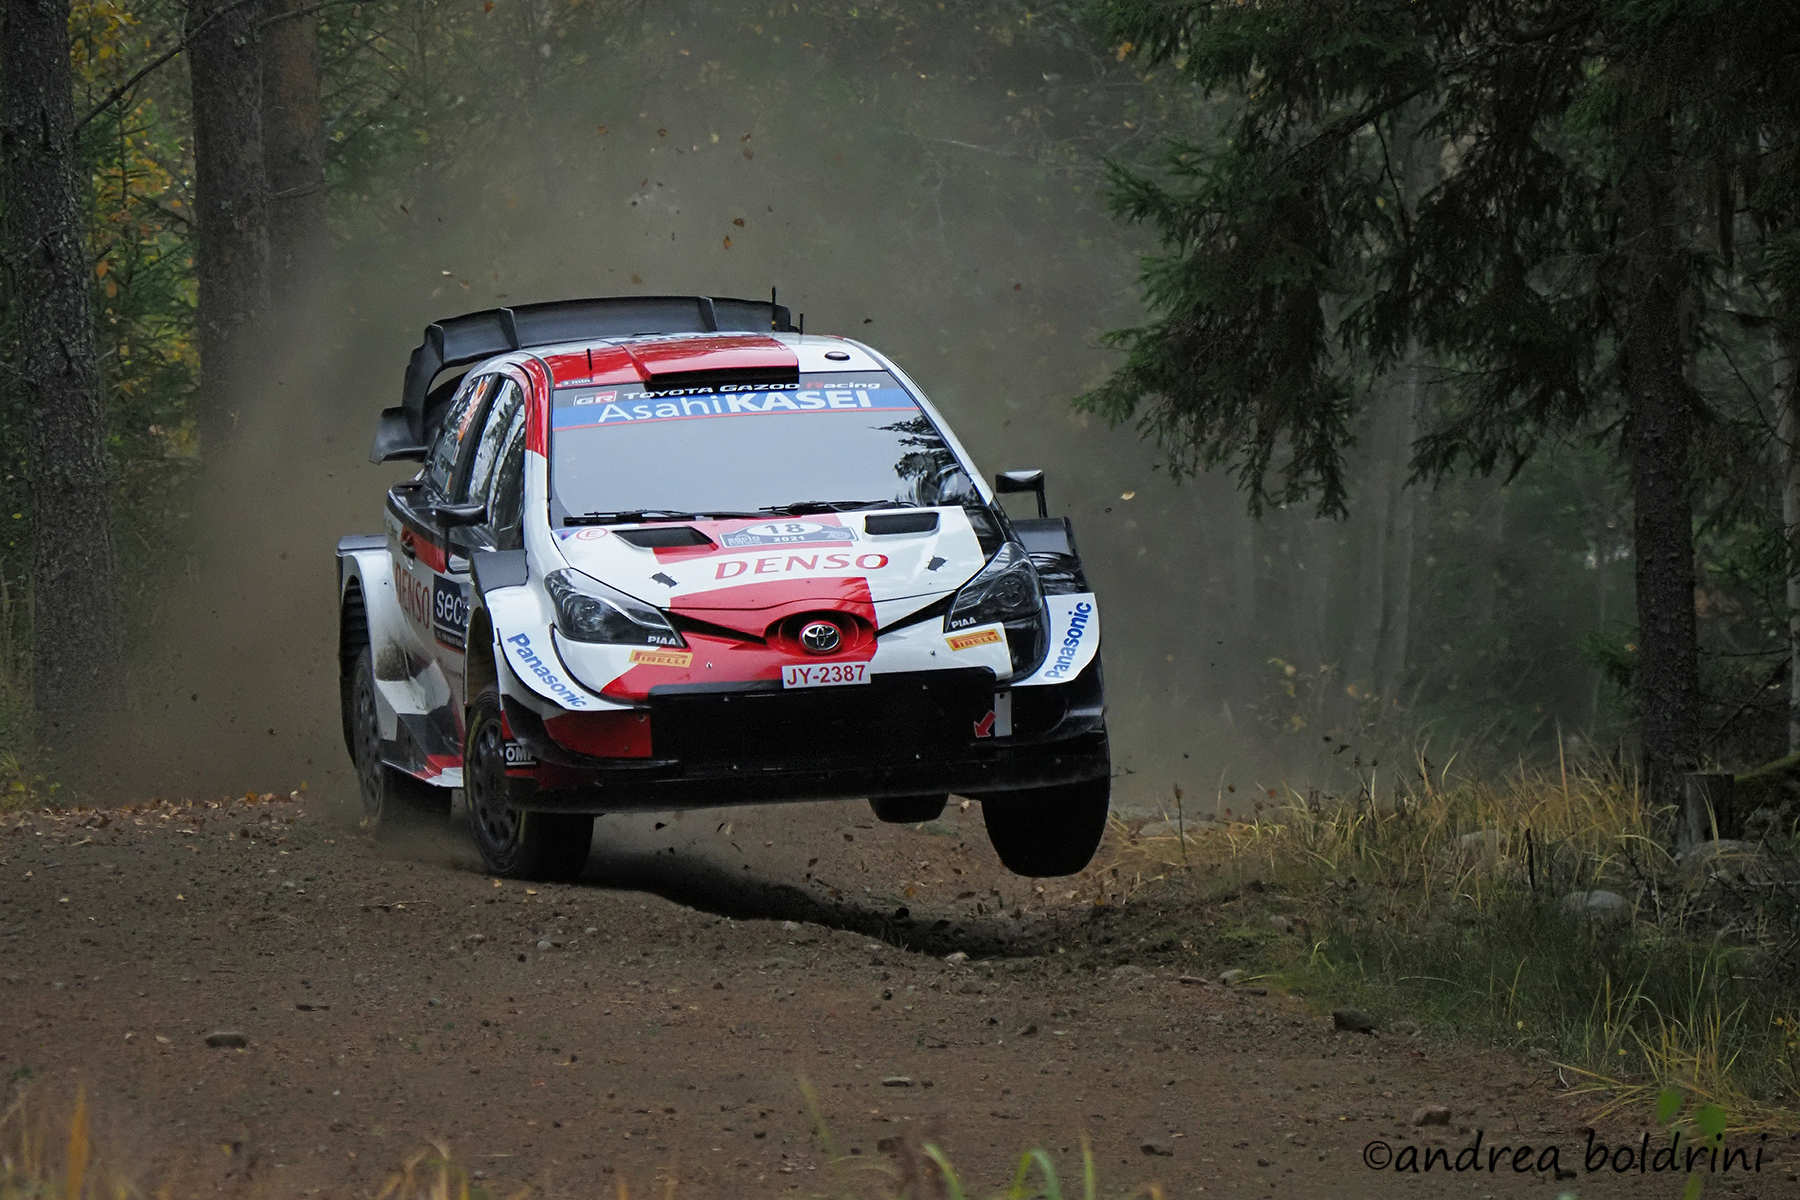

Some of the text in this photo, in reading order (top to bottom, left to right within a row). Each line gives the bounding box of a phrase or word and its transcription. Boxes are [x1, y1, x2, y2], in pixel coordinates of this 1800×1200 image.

[576, 382, 881, 405] GR TOYOTA GAZOO Racing
[764, 523, 805, 534] 18
[715, 553, 889, 580] DENSO
[394, 561, 430, 630] DENSO
[951, 616, 978, 629] PIAA
[647, 635, 677, 645] PIAA
[949, 631, 999, 649] PIRELLI
[1044, 602, 1092, 679] Panasonic
[633, 651, 688, 665] PIRELLI
[507, 632, 587, 707] Panasonic
[787, 664, 866, 686] JY-2387
